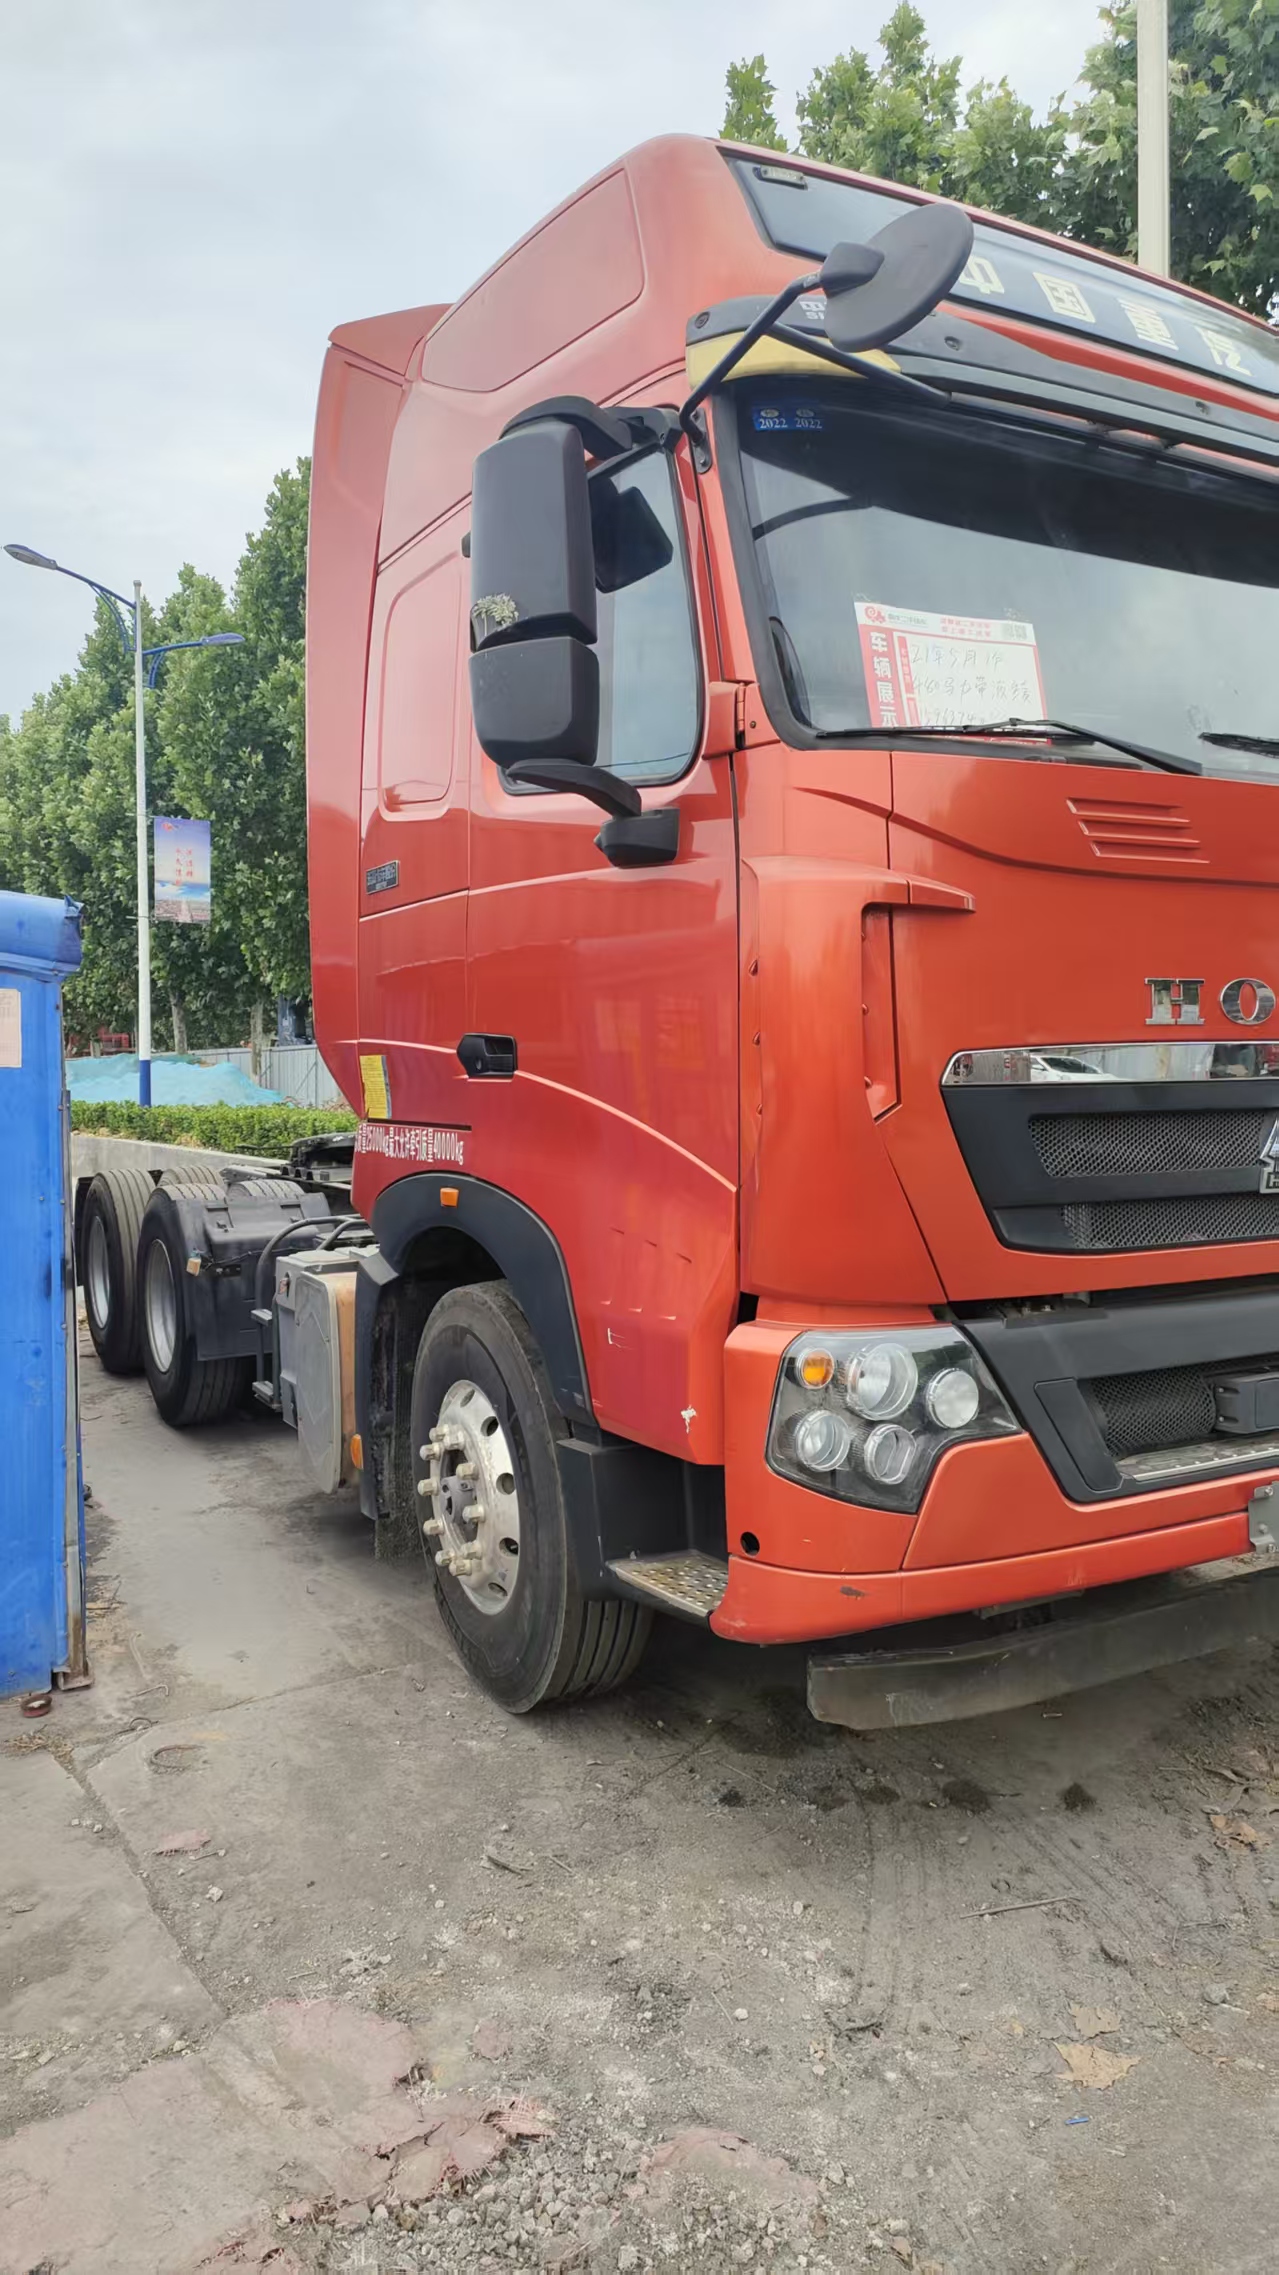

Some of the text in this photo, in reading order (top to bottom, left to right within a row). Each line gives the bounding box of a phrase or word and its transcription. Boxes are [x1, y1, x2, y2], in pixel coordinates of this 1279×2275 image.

[800, 301, 827, 311] 中
[958, 254, 1253, 377] 中国重汽
[759, 418, 822, 429] 2022 2022
[870, 631, 898, 728] 车辆展示
[1145, 977, 1276, 1025] HO
